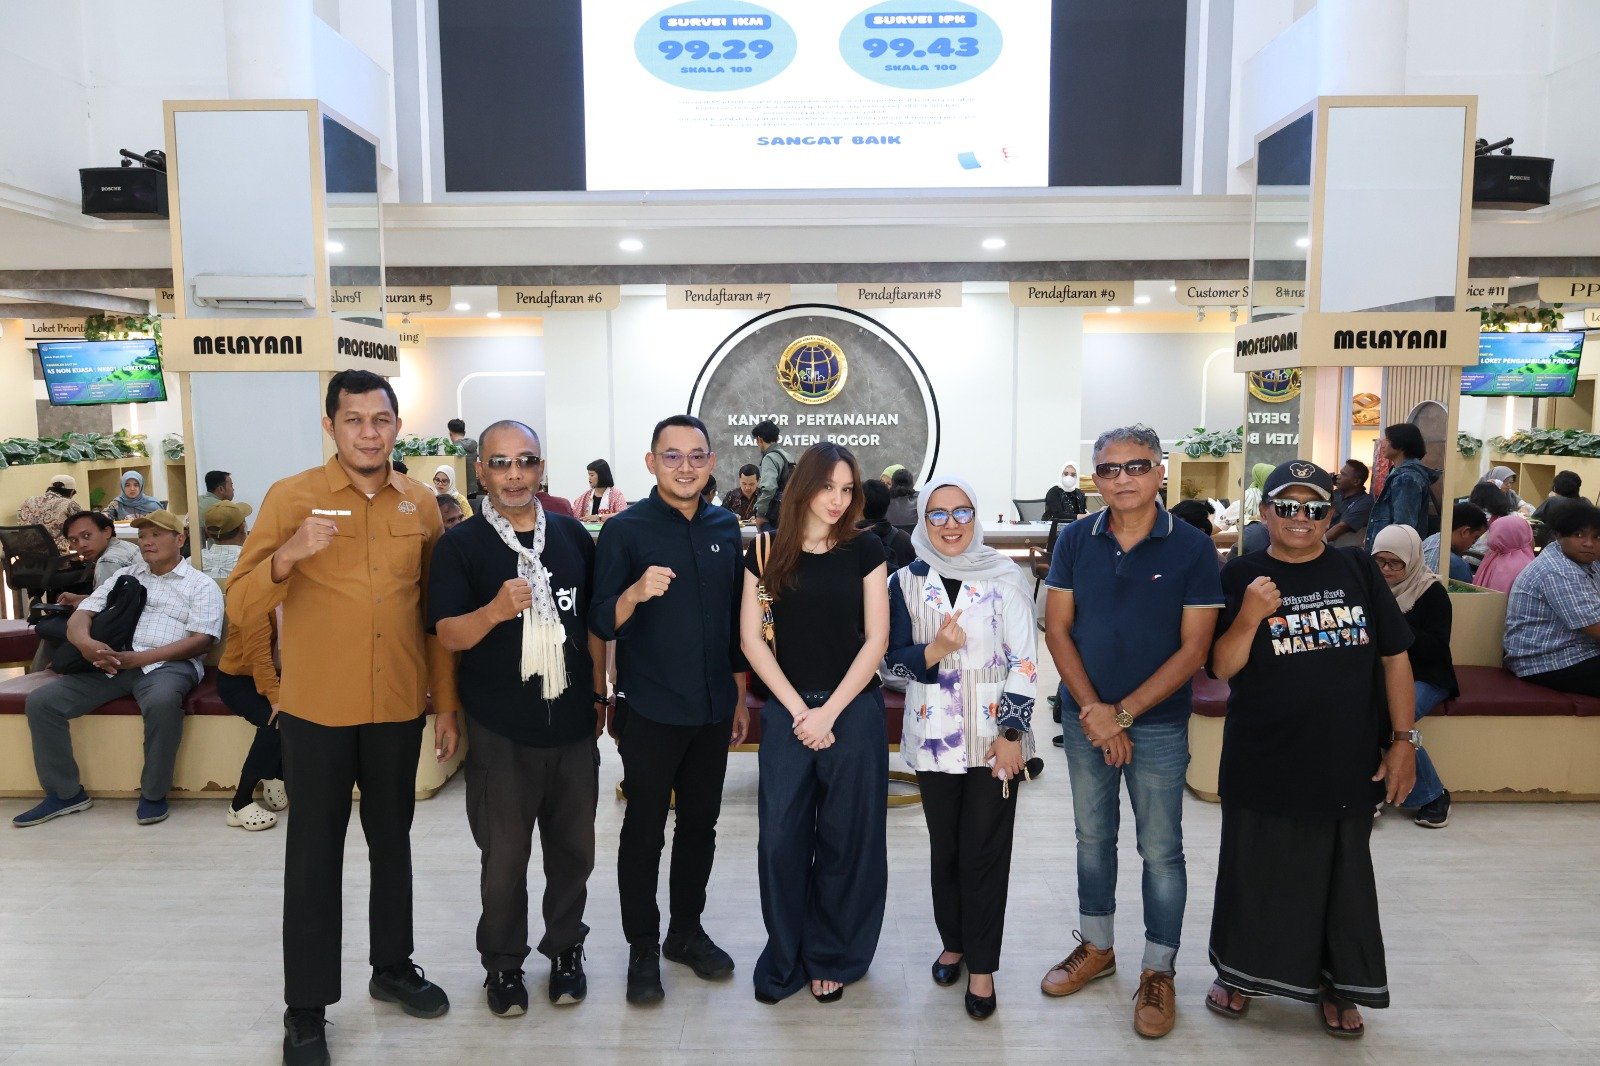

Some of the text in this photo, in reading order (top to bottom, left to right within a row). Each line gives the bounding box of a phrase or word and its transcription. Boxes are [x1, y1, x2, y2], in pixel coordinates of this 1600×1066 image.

[667, 17, 764, 27] SURVEI IKM
[872, 14, 966, 25] SURVEI IPK
[658, 39, 774, 60] 99.29
[862, 36, 980, 58] 99.43
[756, 135, 901, 146] SANGAT BAIK
[418, 293, 433, 306] #5
[515, 291, 603, 308] Pendaftaran #6
[684, 289, 771, 306] Pendaftaran #7
[1028, 286, 1116, 303] Pendaftaran #9
[1187, 286, 1241, 298] Customer
[1487, 286, 1505, 297] #11
[32, 322, 56, 333] Loket
[193, 335, 303, 355] MELAYANI
[1236, 331, 1298, 357] PROFESIONAL
[1334, 329, 1447, 350] MELAYANI
[337, 336, 398, 362] PROFESIONAL
[728, 413, 899, 426] KANTOR PERTANAHAN
[827, 433, 881, 447] BOGOR
[1267, 605, 1368, 638] PENANG
[1271, 627, 1371, 656] MALAYSIA
